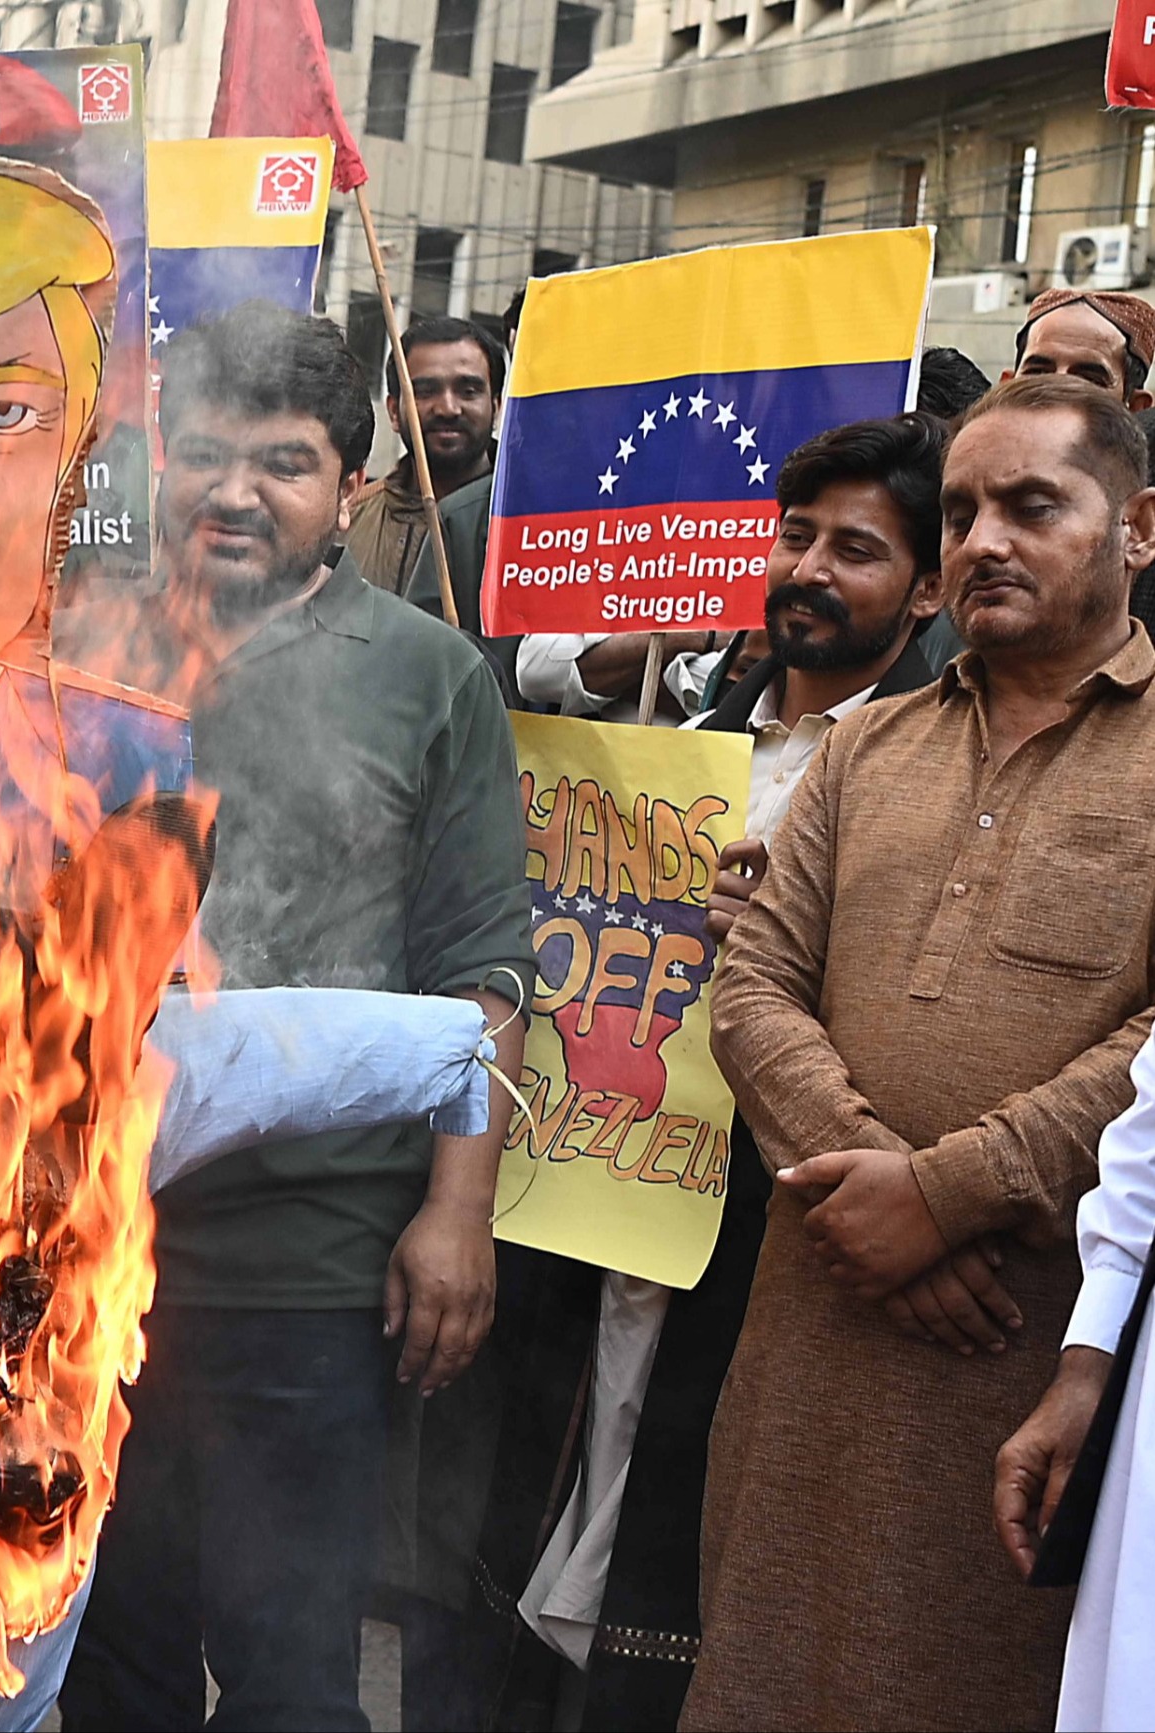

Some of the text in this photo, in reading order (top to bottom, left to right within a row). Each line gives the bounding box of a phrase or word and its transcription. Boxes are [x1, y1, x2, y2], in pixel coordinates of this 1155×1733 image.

[502, 558, 614, 590] People's
[521, 514, 777, 553] Long Live Venezu
[601, 591, 724, 623] Struggle
[519, 770, 729, 905] HANDS
[532, 916, 704, 1047] OFF
[504, 1065, 729, 1198] NEZUELA
